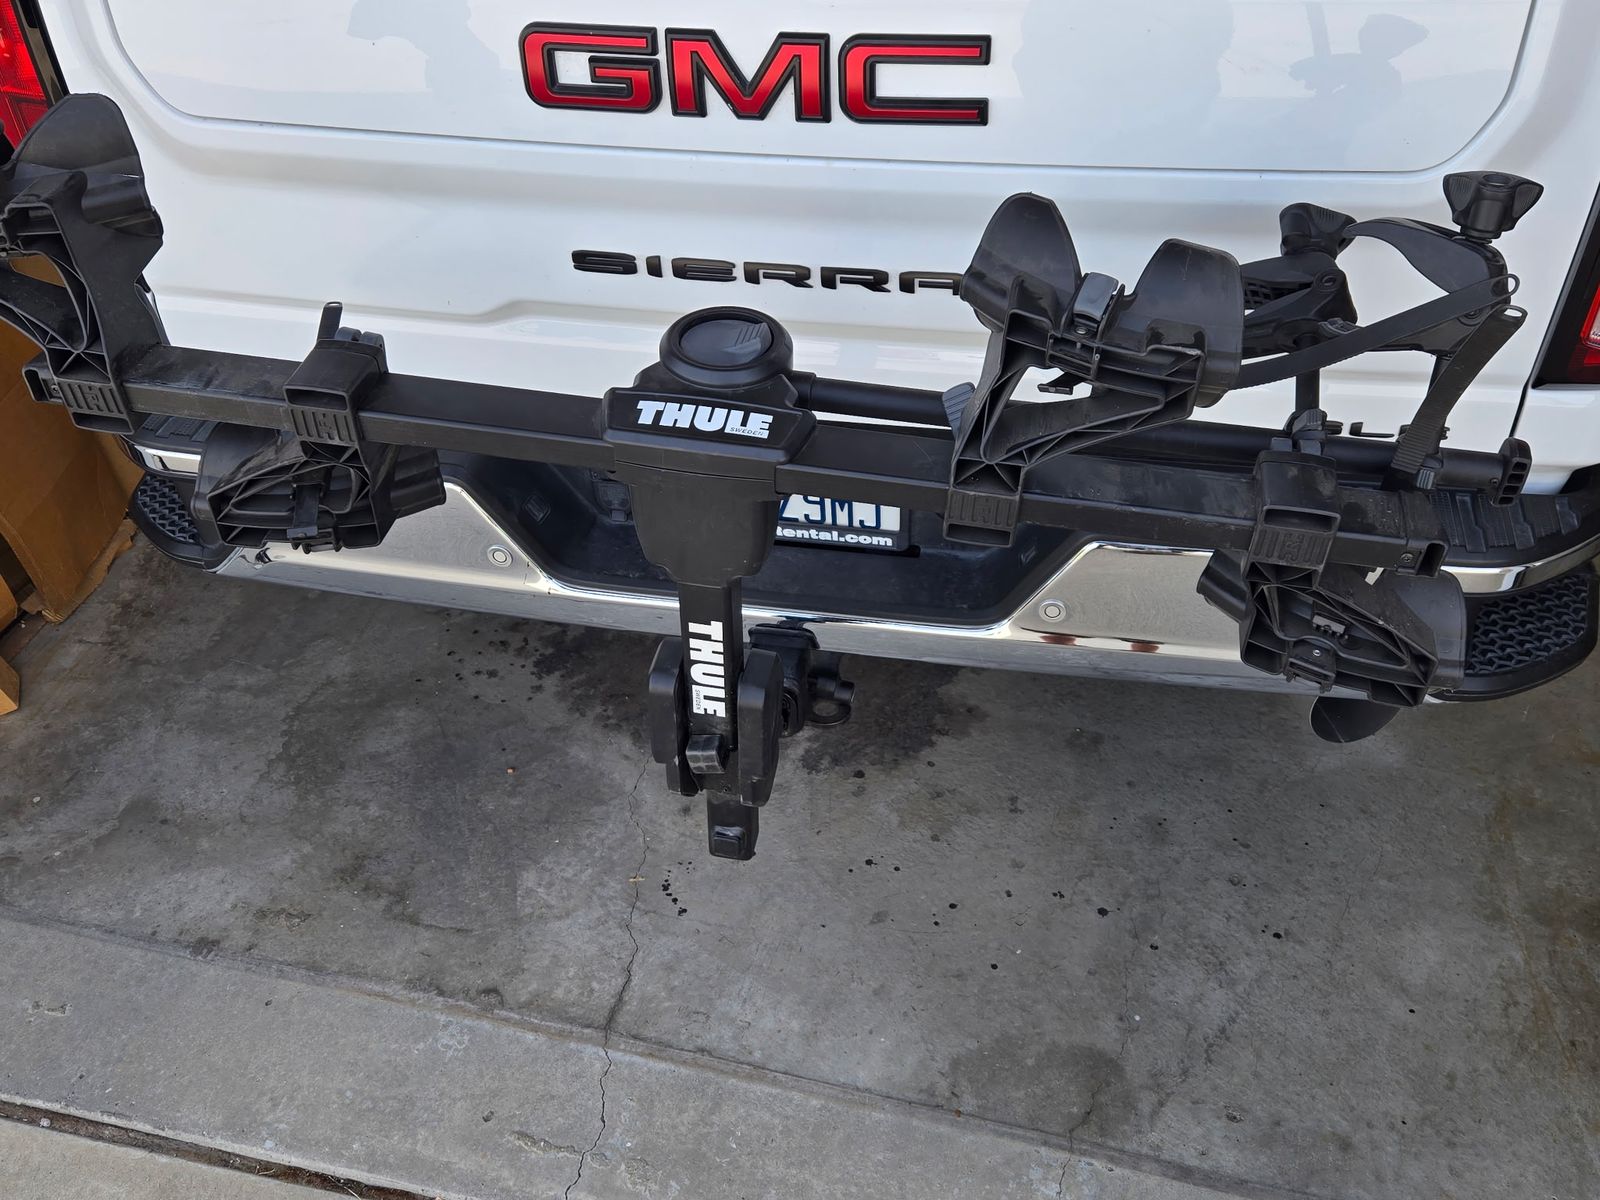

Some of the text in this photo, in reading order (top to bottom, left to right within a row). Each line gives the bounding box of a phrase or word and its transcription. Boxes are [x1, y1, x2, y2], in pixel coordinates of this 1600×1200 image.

[518, 21, 992, 127] GMC
[571, 249, 963, 297] SIERRA
[636, 400, 774, 440] THULE
[729, 426, 764, 437] SWEDEN
[687, 620, 727, 719] THULE
